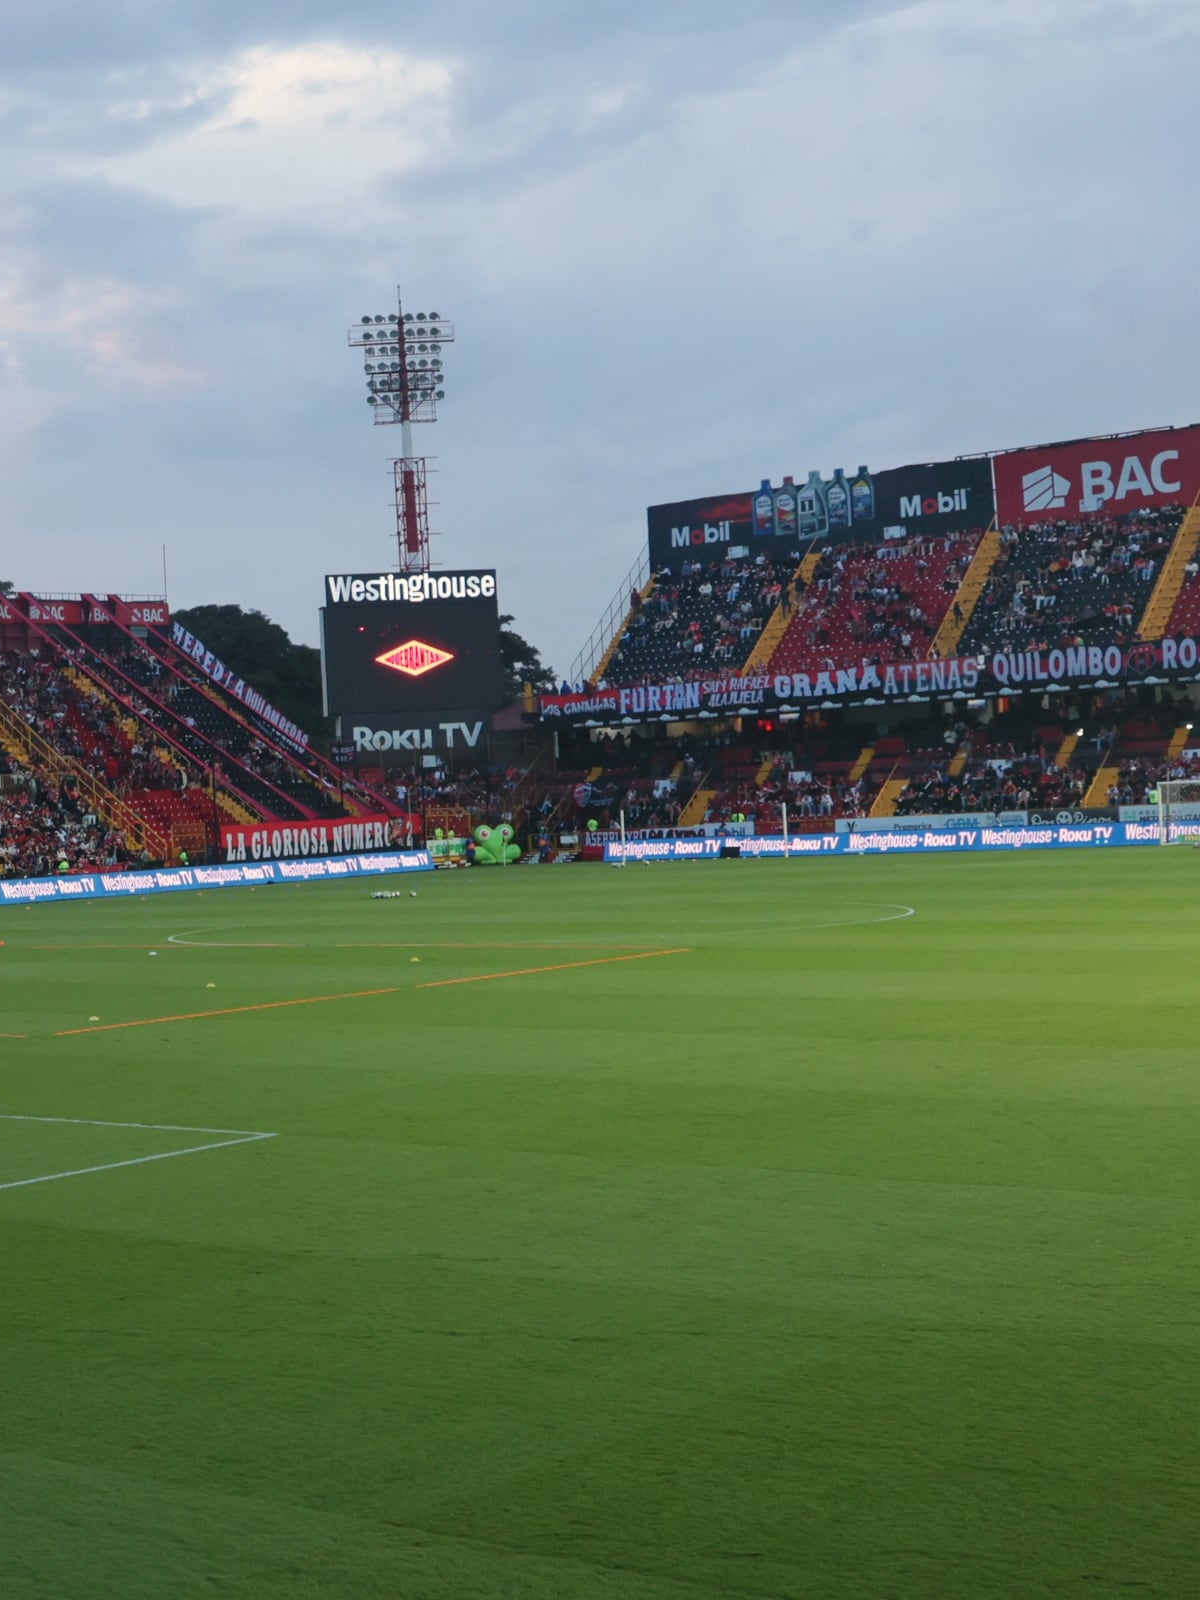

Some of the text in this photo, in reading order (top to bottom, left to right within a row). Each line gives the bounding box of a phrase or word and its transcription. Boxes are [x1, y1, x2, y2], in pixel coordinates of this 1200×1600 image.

[1081, 450, 1181, 503] BAC
[900, 489, 968, 518] Mobil
[671, 521, 731, 548] Mobil
[328, 574, 496, 602] Westinghouse
[143, 607, 164, 622] BAC
[993, 645, 1122, 685] QUILOMBO
[702, 675, 772, 695] SAN RAFAEL
[774, 664, 881, 698] GRANA
[884, 658, 979, 695] ATENAS
[439, 721, 483, 747] TV
[226, 833, 247, 861] LA
[251, 827, 329, 860] GLORIOSA
[406, 821, 413, 847] 2
[704, 839, 721, 853] TV
[822, 837, 839, 849] TV
[850, 833, 918, 851] Westinghouse
[958, 831, 978, 846] TV
[982, 829, 1051, 848] Westinghouse
[1094, 827, 1113, 839] TV
[262, 865, 274, 879] TV
[345, 858, 358, 872] TV
[1, 881, 56, 899] Westinghouse
[81, 878, 95, 892] TV
[101, 873, 156, 892] Westinghouse
[179, 871, 193, 885] TV
